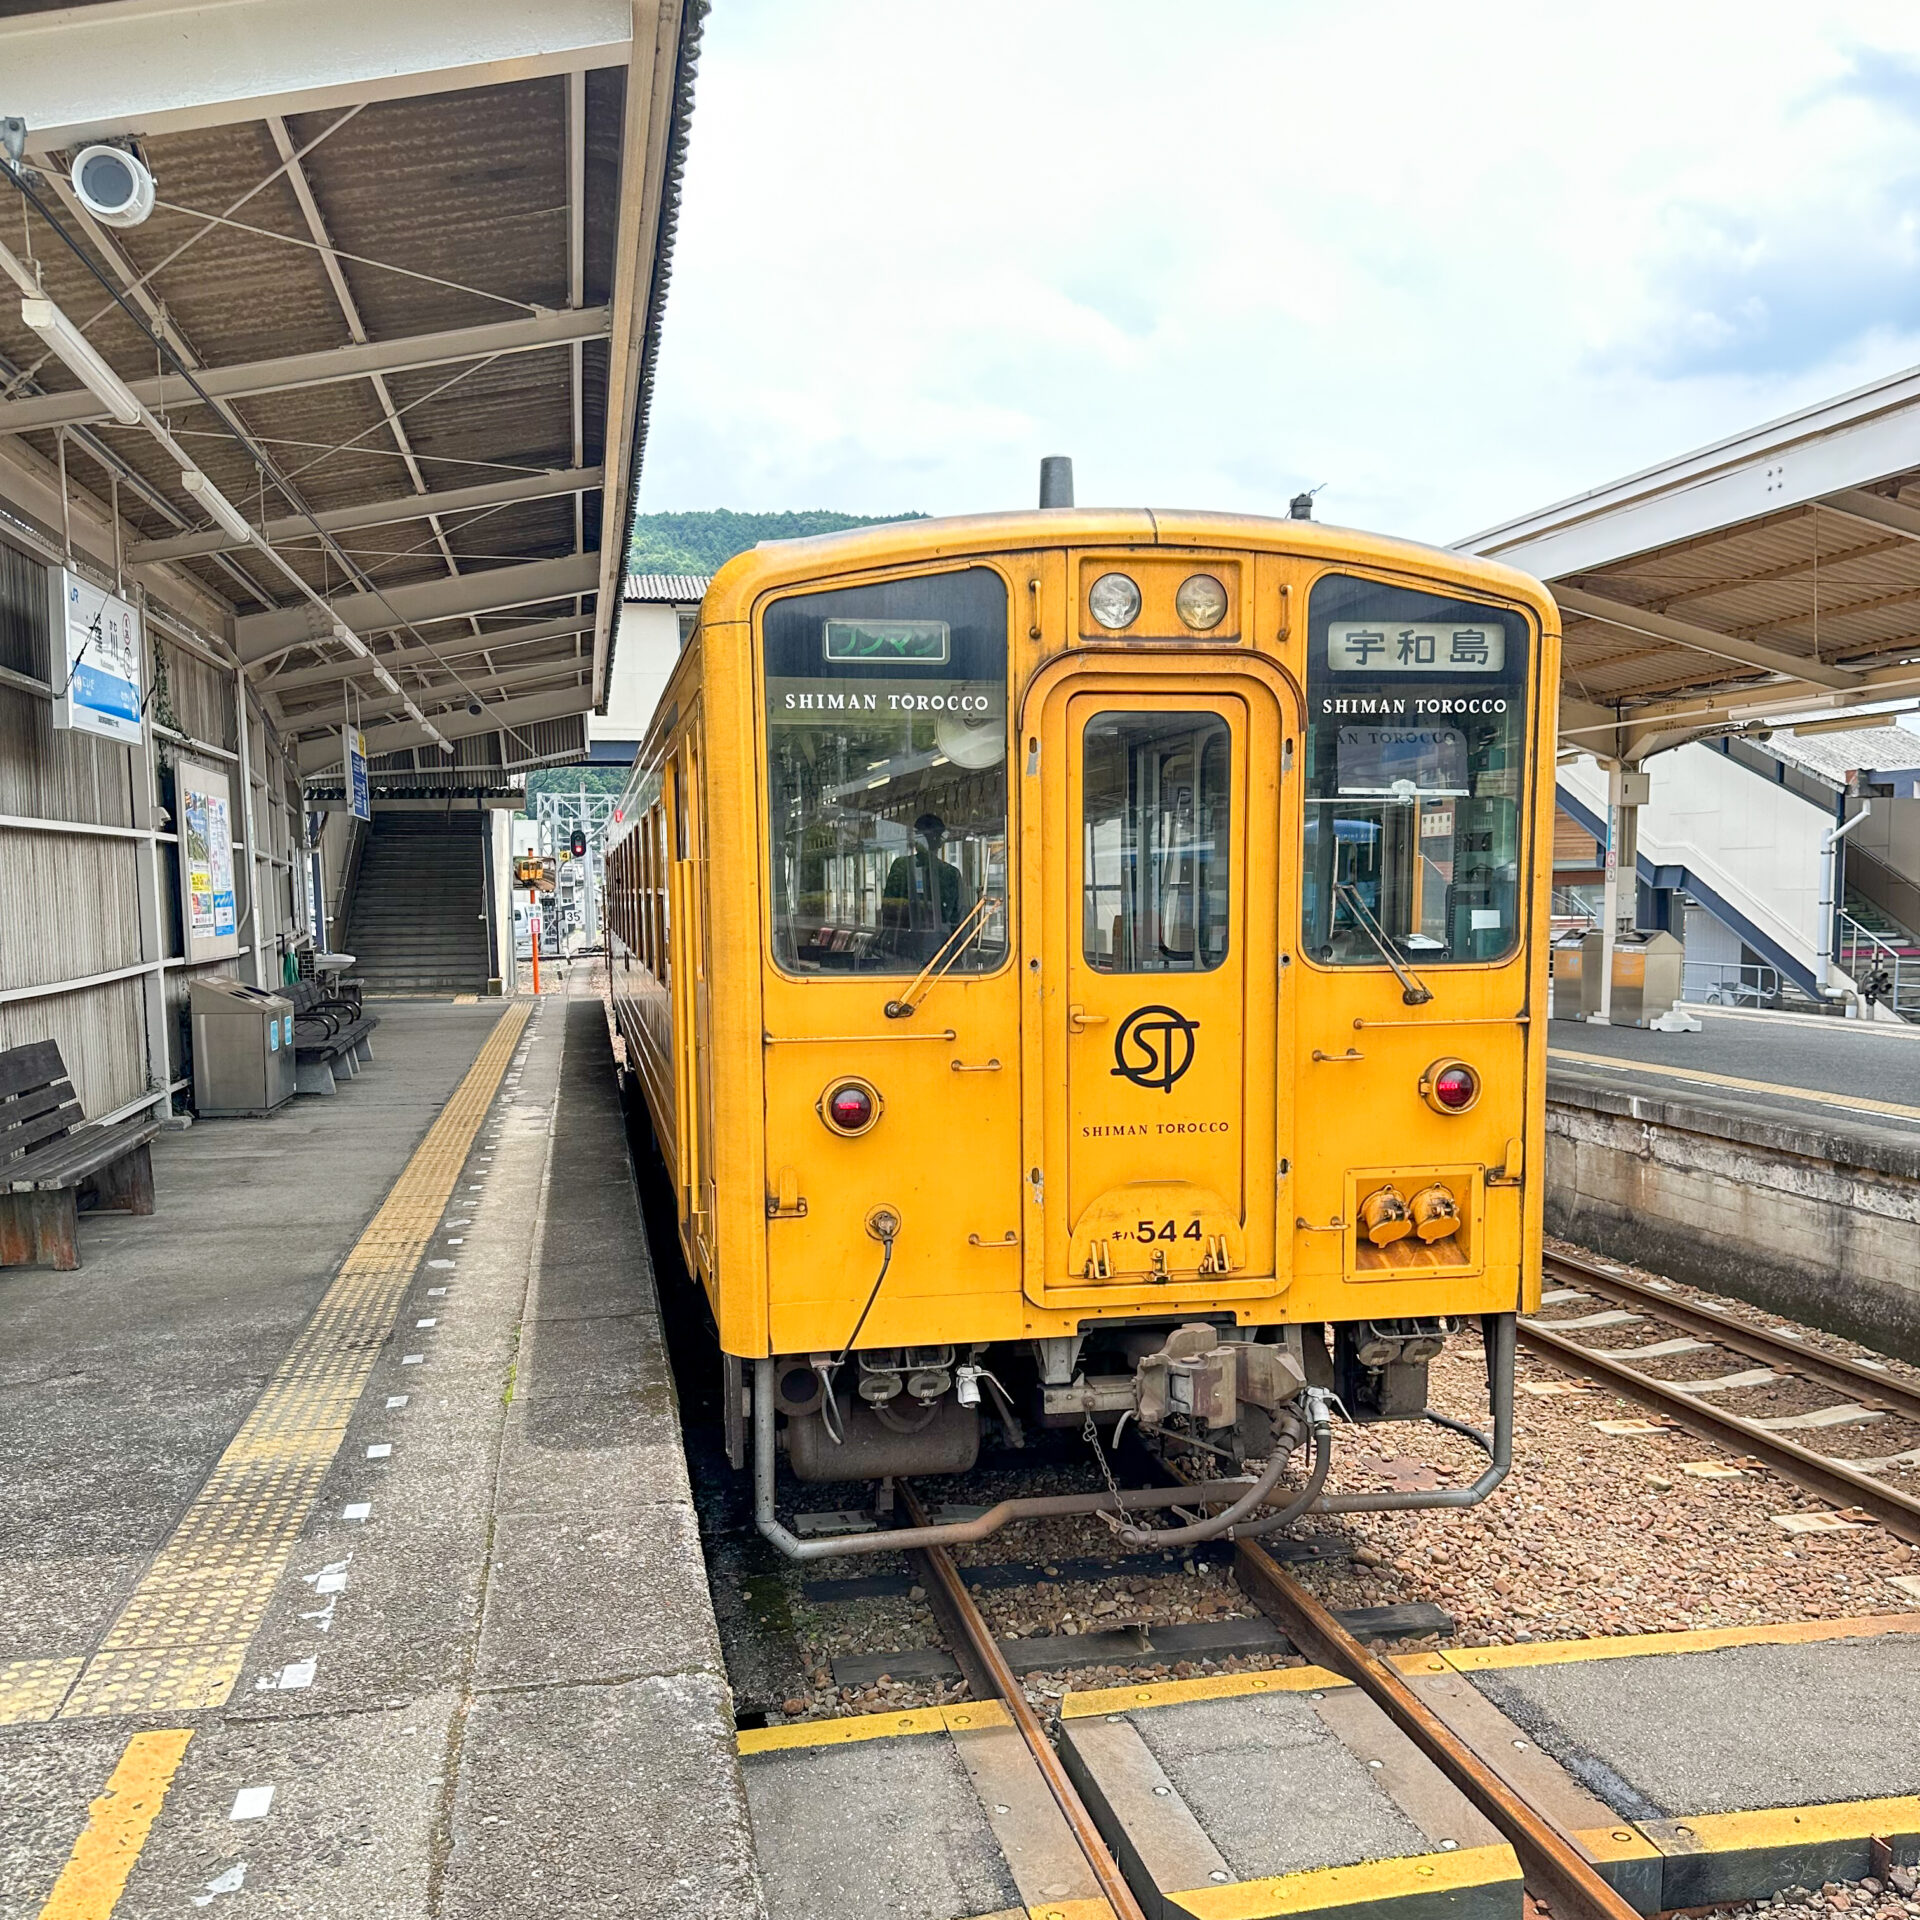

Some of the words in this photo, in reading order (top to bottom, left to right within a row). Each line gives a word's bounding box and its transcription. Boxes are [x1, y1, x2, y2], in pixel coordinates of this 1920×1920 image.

[71, 587, 79, 603] JR
[1345, 629, 1489, 665] 宇和島
[785, 693, 877, 710] SHIMAN
[888, 694, 989, 711] TOROCCO
[1322, 699, 1406, 714] SHIMAN
[1415, 699, 1507, 714] TOROCCO
[566, 911, 581, 922] 35
[1082, 1124, 1148, 1137] SHIMAN
[1156, 1122, 1229, 1135] TOROCCO
